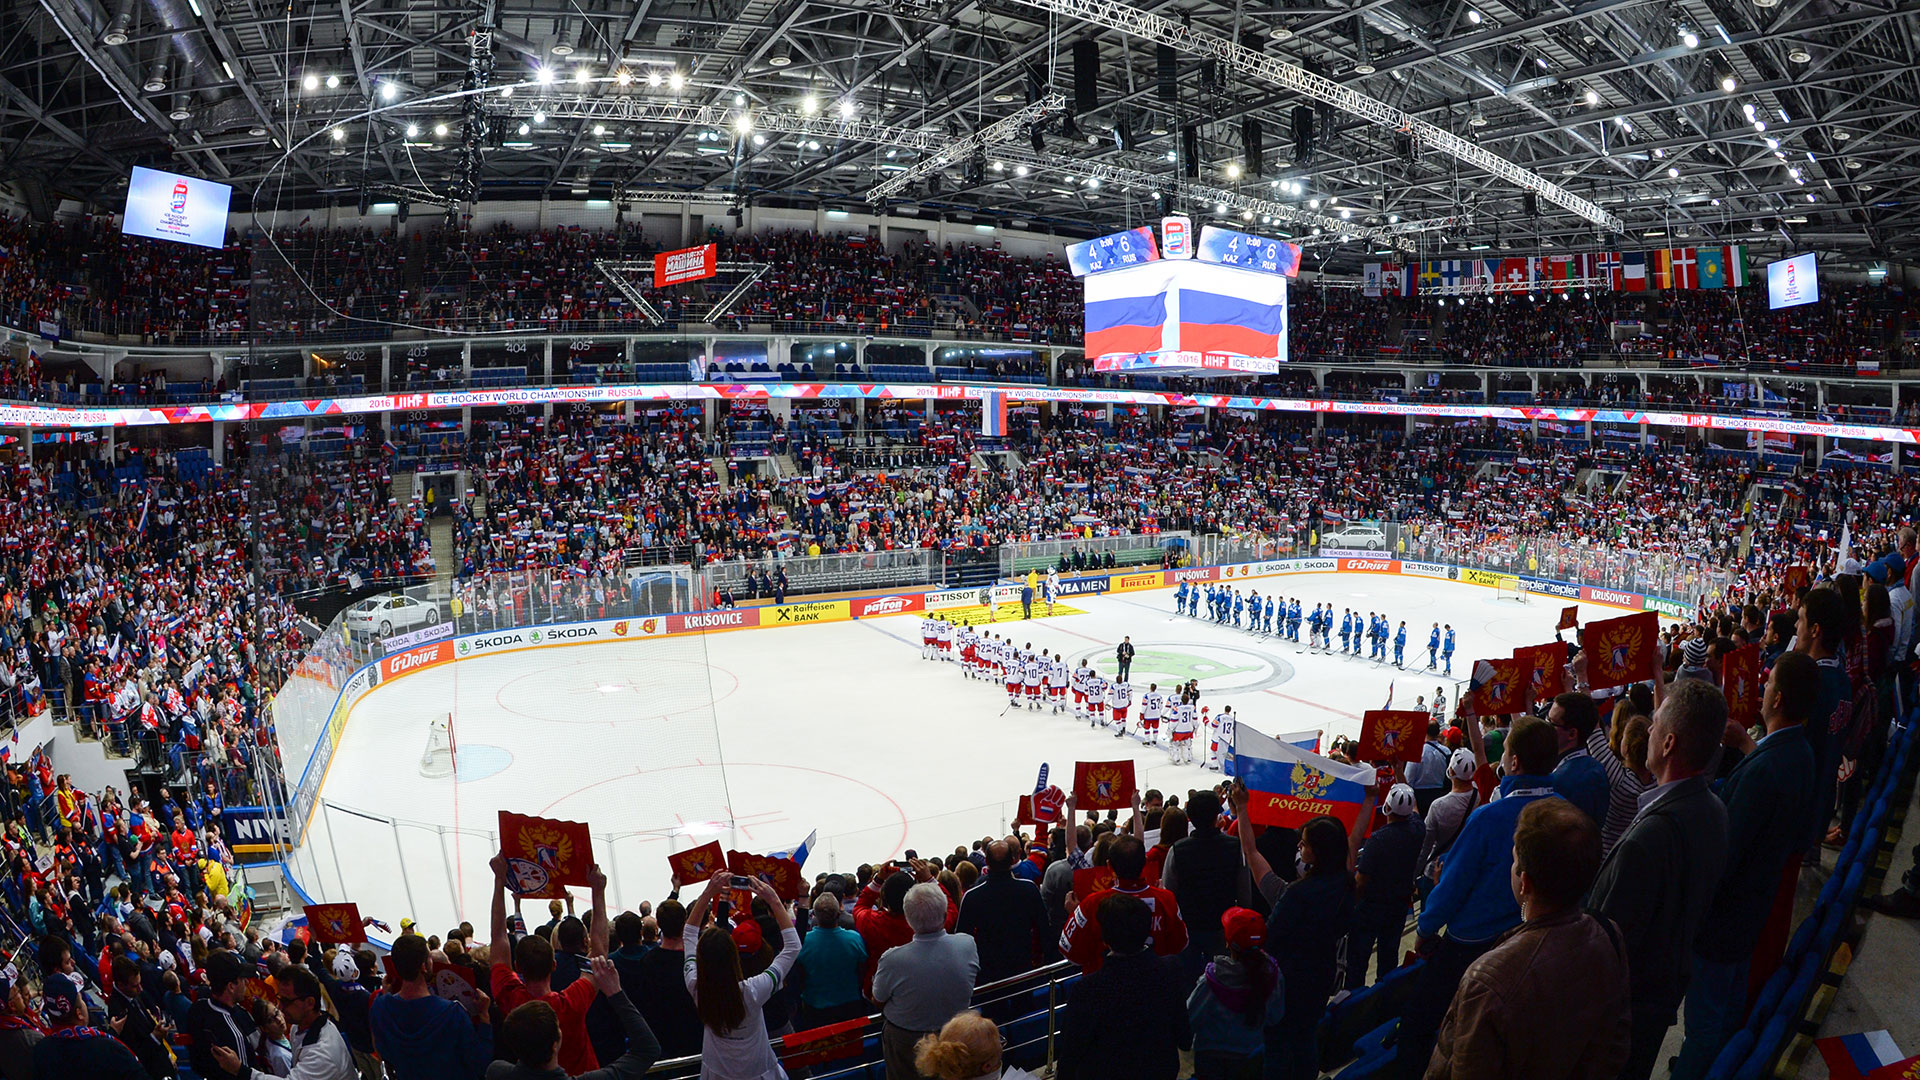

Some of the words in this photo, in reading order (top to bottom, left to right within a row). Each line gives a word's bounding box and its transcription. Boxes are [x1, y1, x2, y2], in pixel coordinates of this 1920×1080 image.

[1089, 244, 1097, 259] 4
[1100, 238, 1114, 248] 0:00
[1120, 235, 1130, 252] 6
[1228, 236, 1238, 252] 4
[1246, 237, 1261, 247] 0:00
[1267, 244, 1276, 259] 6
[666, 256, 704, 272] МАШИНА
[1090, 261, 1103, 270] KAZ
[1122, 254, 1137, 264] RUS
[1223, 254, 1239, 263] KAZ
[1262, 261, 1276, 270] RUS
[506, 342, 527, 353] 404
[570, 341, 590, 351] 405
[346, 351, 365, 361] 402
[408, 348, 427, 358] 403
[1177, 354, 1199, 364] 2016
[1233, 359, 1245, 368] ICE
[1603, 374, 1618, 383] 410
[1672, 376, 1686, 385] 411
[1790, 382, 1805, 391] 412
[369, 399, 390, 408] 2016
[399, 396, 423, 408] IIHF
[433, 396, 449, 404] ICE
[451, 394, 491, 403] HOCKEY
[492, 392, 528, 402] WORLD
[530, 389, 603, 400] CHAMPIONSHIP
[608, 388, 642, 397] RUSSIA
[1042, 391, 1093, 399] CHAMPIONSHIP
[571, 402, 591, 413] 305
[668, 400, 687, 410] 306
[730, 399, 749, 408] 307
[822, 399, 840, 407] 308
[879, 399, 897, 407] 309
[962, 400, 979, 408] 310
[1070, 402, 1084, 410] 312
[506, 404, 526, 416] 304
[1403, 406, 1452, 414] CHAMPIONSHIP
[23, 410, 42, 422] WORLD
[84, 413, 107, 422] RUSSIA
[346, 415, 364, 425] 302
[408, 411, 428, 421] 303
[1604, 422, 1618, 430] 318
[1672, 425, 1686, 434] 319
[1728, 420, 1757, 429] HOCKEY
[1758, 422, 1784, 430] WORLD
[1785, 423, 1839, 433] CHAMPIONSHIP
[1842, 427, 1866, 436] RUSSIA
[1265, 563, 1290, 572] ŠKODA
[1304, 560, 1334, 569] ŠKODA
[1417, 564, 1444, 572] TISSOT
[1081, 579, 1108, 591] MEN
[1121, 575, 1155, 588] PIRELLI
[1479, 578, 1494, 586] БАНК
[940, 591, 975, 601] TISSOT
[1591, 589, 1631, 605] KRUŠOVICE
[793, 602, 835, 613] Raiffeisen
[864, 600, 903, 616] patron
[684, 612, 742, 629] KRUŠOVICE
[794, 613, 819, 622] BANK
[424, 626, 450, 638] ŠKODA
[925, 623, 935, 632] 72
[548, 627, 597, 640] ŠKODA
[475, 634, 523, 650] ŠKODA
[1005, 652, 1010, 660] 9
[1028, 669, 1037, 679] 10
[1057, 667, 1063, 678] 7
[1089, 686, 1100, 696] 63
[1117, 688, 1126, 700] 16
[1182, 712, 1191, 723] 31
[1222, 723, 1231, 734] 13
[1038, 767, 1047, 788] RUSSIA
[1268, 797, 1333, 815] РОССИЯ
[1065, 916, 1077, 938] 13
